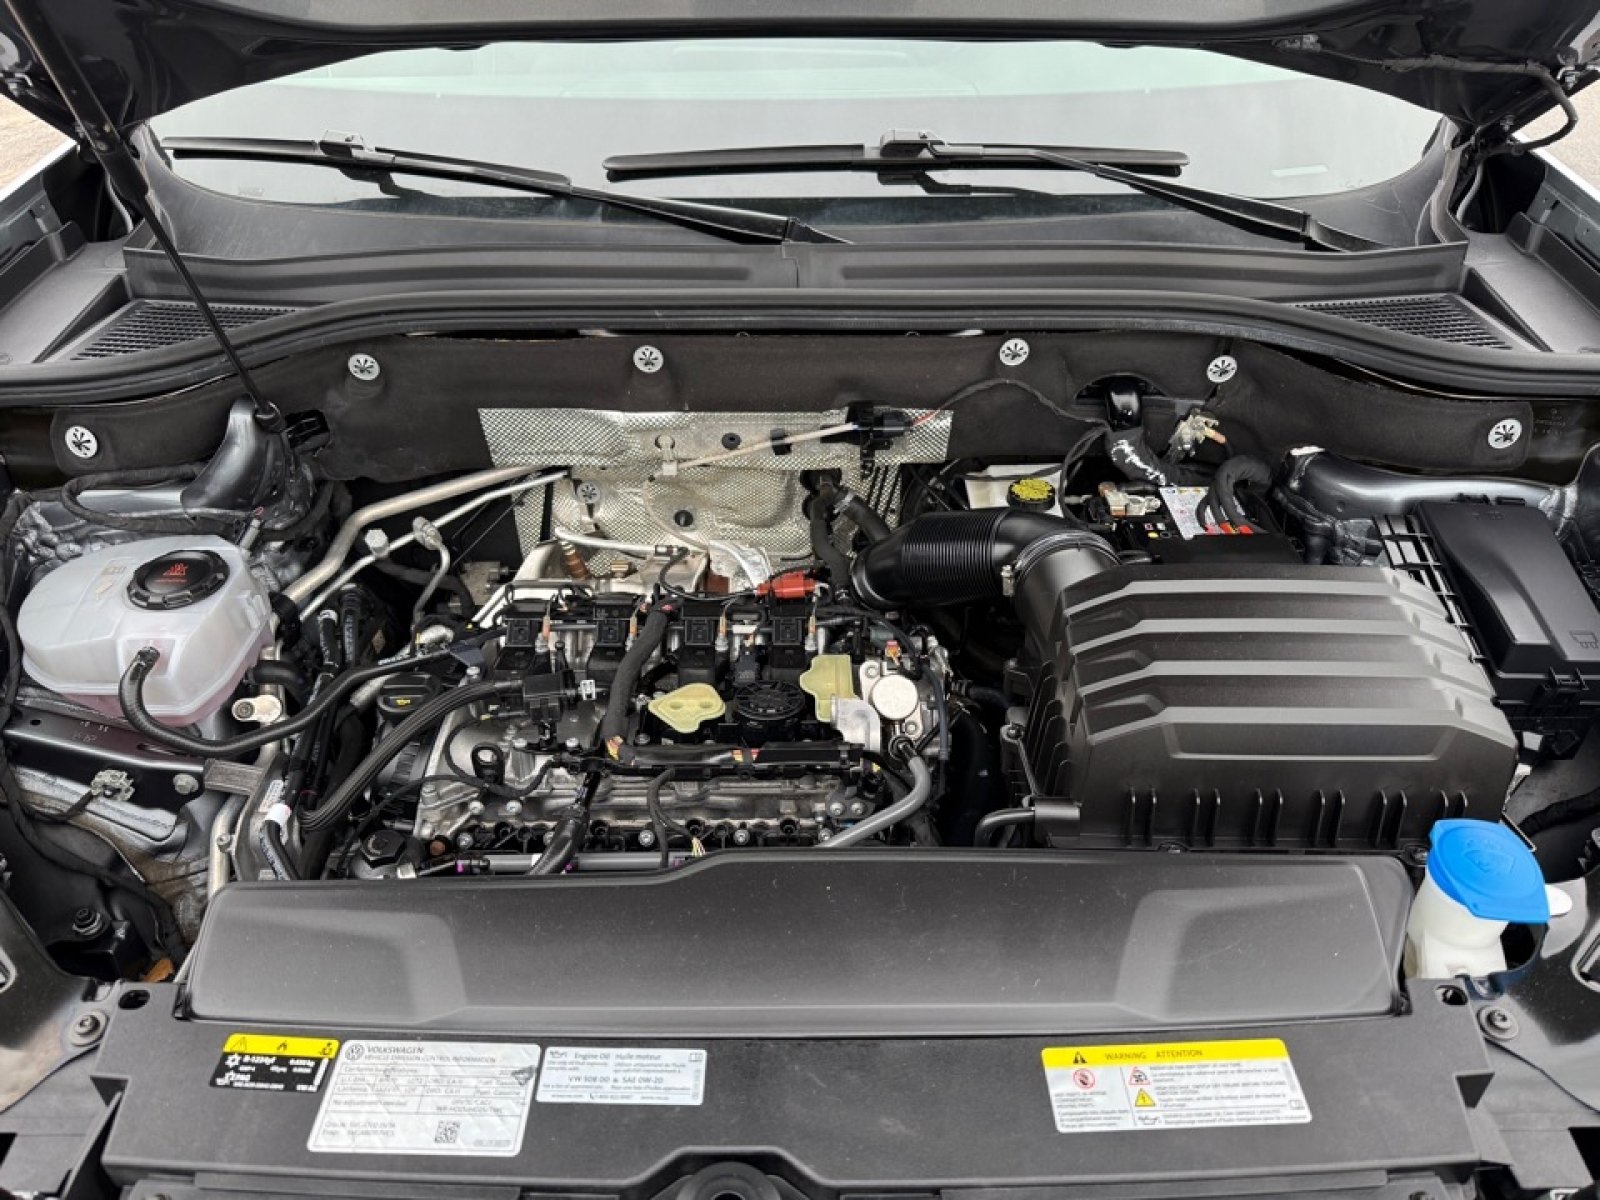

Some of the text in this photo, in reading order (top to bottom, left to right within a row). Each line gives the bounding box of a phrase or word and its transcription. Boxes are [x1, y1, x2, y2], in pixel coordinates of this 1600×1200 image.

[367, 1045, 424, 1054] VOLKSWAGEN
[574, 1052, 599, 1060] Engine
[1104, 1049, 1203, 1061] WARNING ATTENTION
